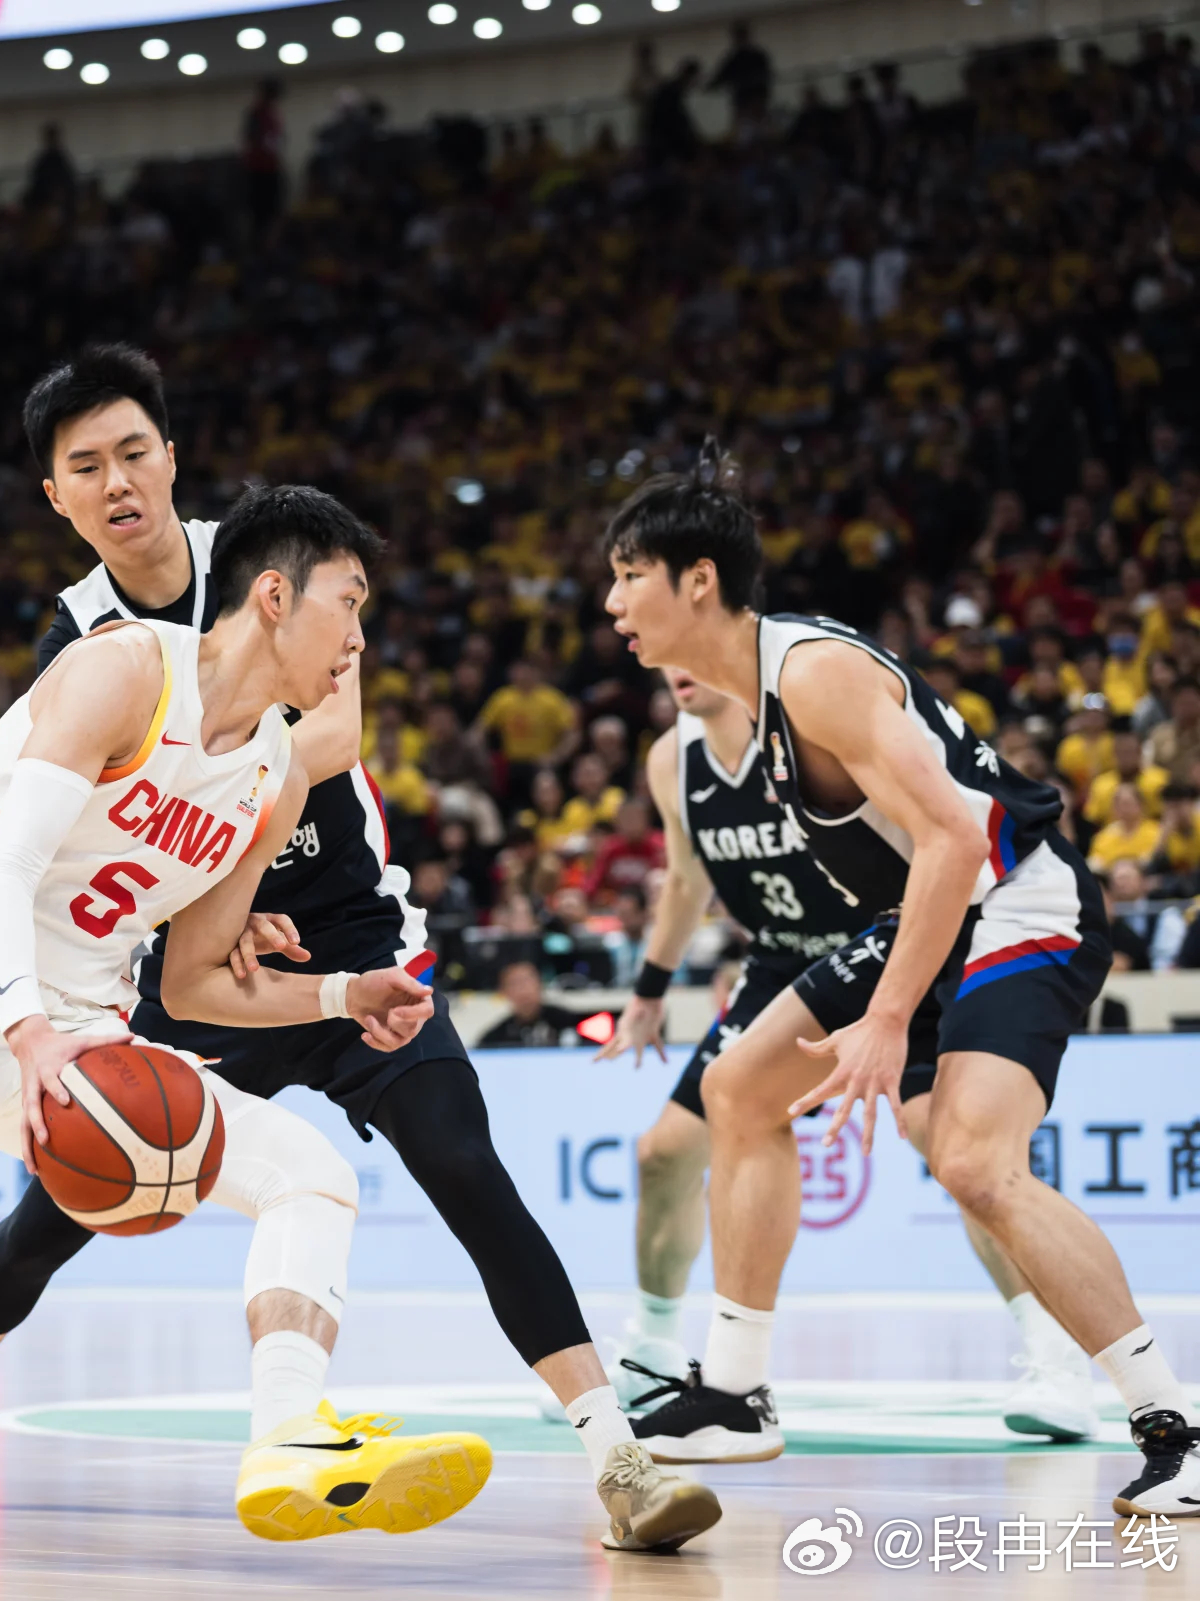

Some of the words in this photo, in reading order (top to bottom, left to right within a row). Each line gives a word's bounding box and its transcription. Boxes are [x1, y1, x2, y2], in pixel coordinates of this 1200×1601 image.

[107, 778, 238, 874] CHINA
[696, 820, 808, 862] KOREA
[69, 860, 161, 939] 5
[749, 870, 805, 921] 33
